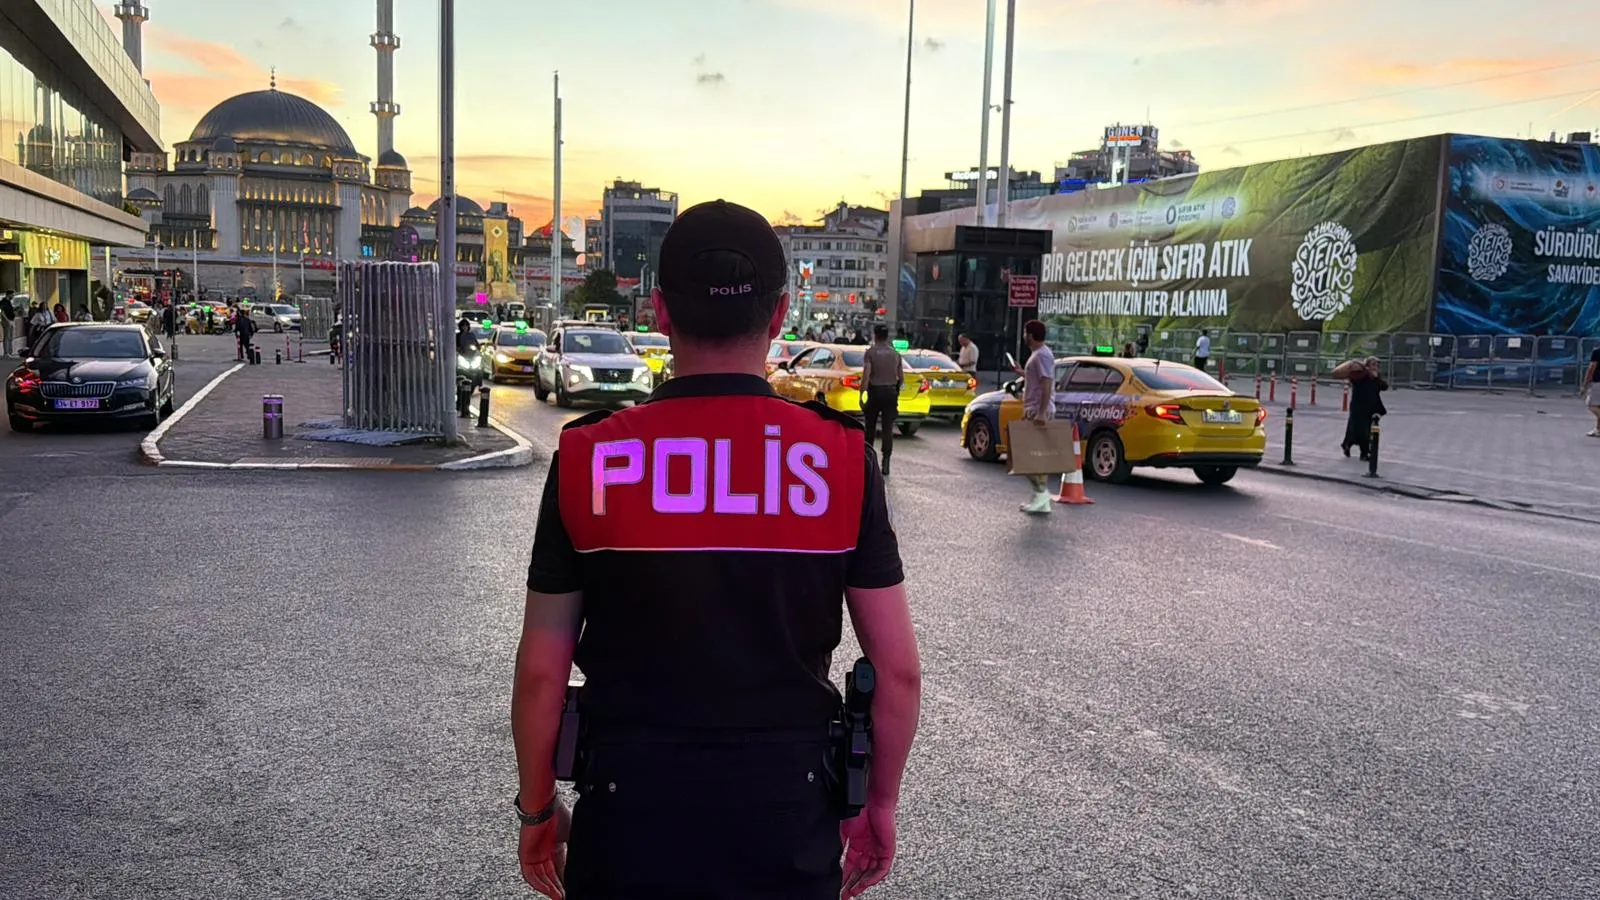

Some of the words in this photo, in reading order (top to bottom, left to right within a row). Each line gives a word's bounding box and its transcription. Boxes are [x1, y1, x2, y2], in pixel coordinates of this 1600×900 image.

[1042, 247, 1063, 283] BİR
[1065, 247, 1126, 282] GELECEK
[1127, 240, 1159, 287] İÇİN
[1161, 243, 1206, 280] SIFIR
[1208, 238, 1253, 278] ATIK
[1295, 240, 1351, 285] SIFIR
[1298, 266, 1353, 299] ATIK
[1078, 291, 1141, 315] HAYATIMIZIN
[1144, 290, 1168, 316] HER
[1170, 289, 1228, 316] ALANINA
[592, 424, 830, 517] POLİS
